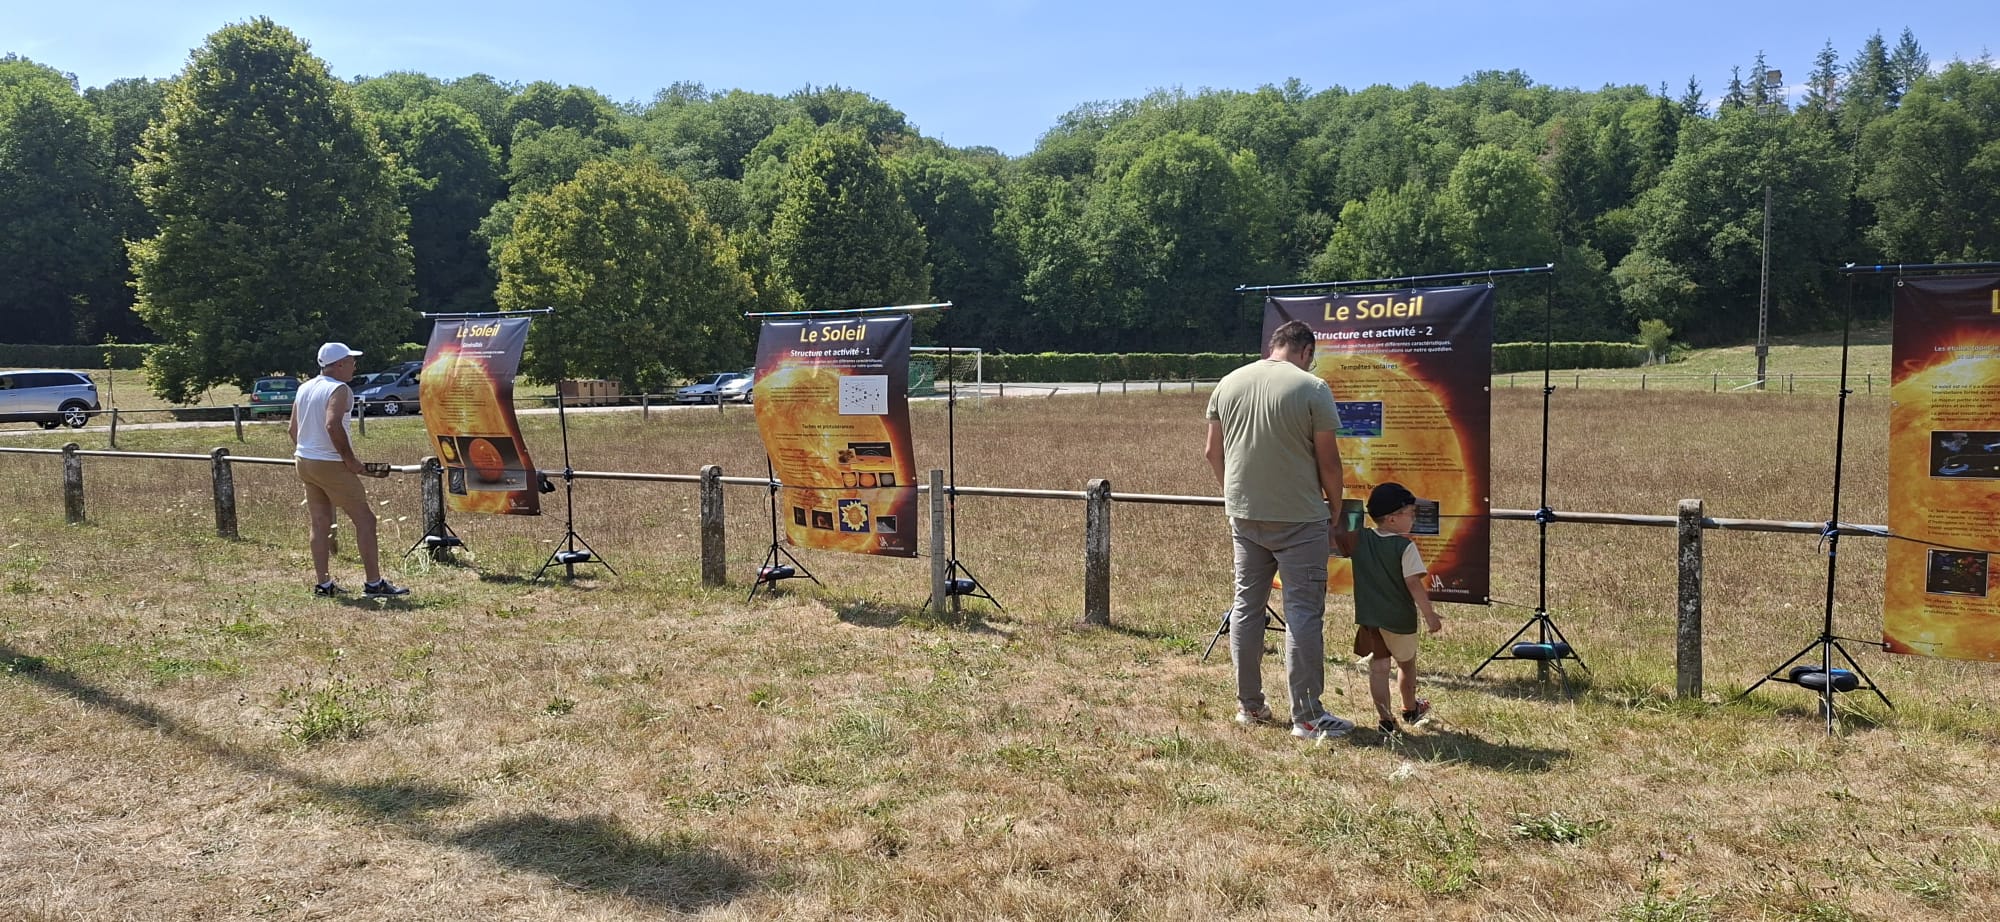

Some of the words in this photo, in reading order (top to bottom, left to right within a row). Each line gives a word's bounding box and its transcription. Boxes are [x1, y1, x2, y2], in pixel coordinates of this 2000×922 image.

[1324, 303, 1350, 321] Le
[1355, 296, 1423, 319] Soleil
[456, 326, 469, 338] Le
[469, 324, 501, 337] Soleil
[800, 328, 818, 342] Le
[821, 325, 866, 341] Soleil
[1312, 330, 1360, 340] Structure
[1362, 330, 1373, 338] et
[1376, 326, 1416, 338] activité
[1425, 326, 1433, 336] 2
[790, 349, 823, 357] Structure
[833, 347, 859, 356] activité
[1430, 574, 1444, 588] JA
